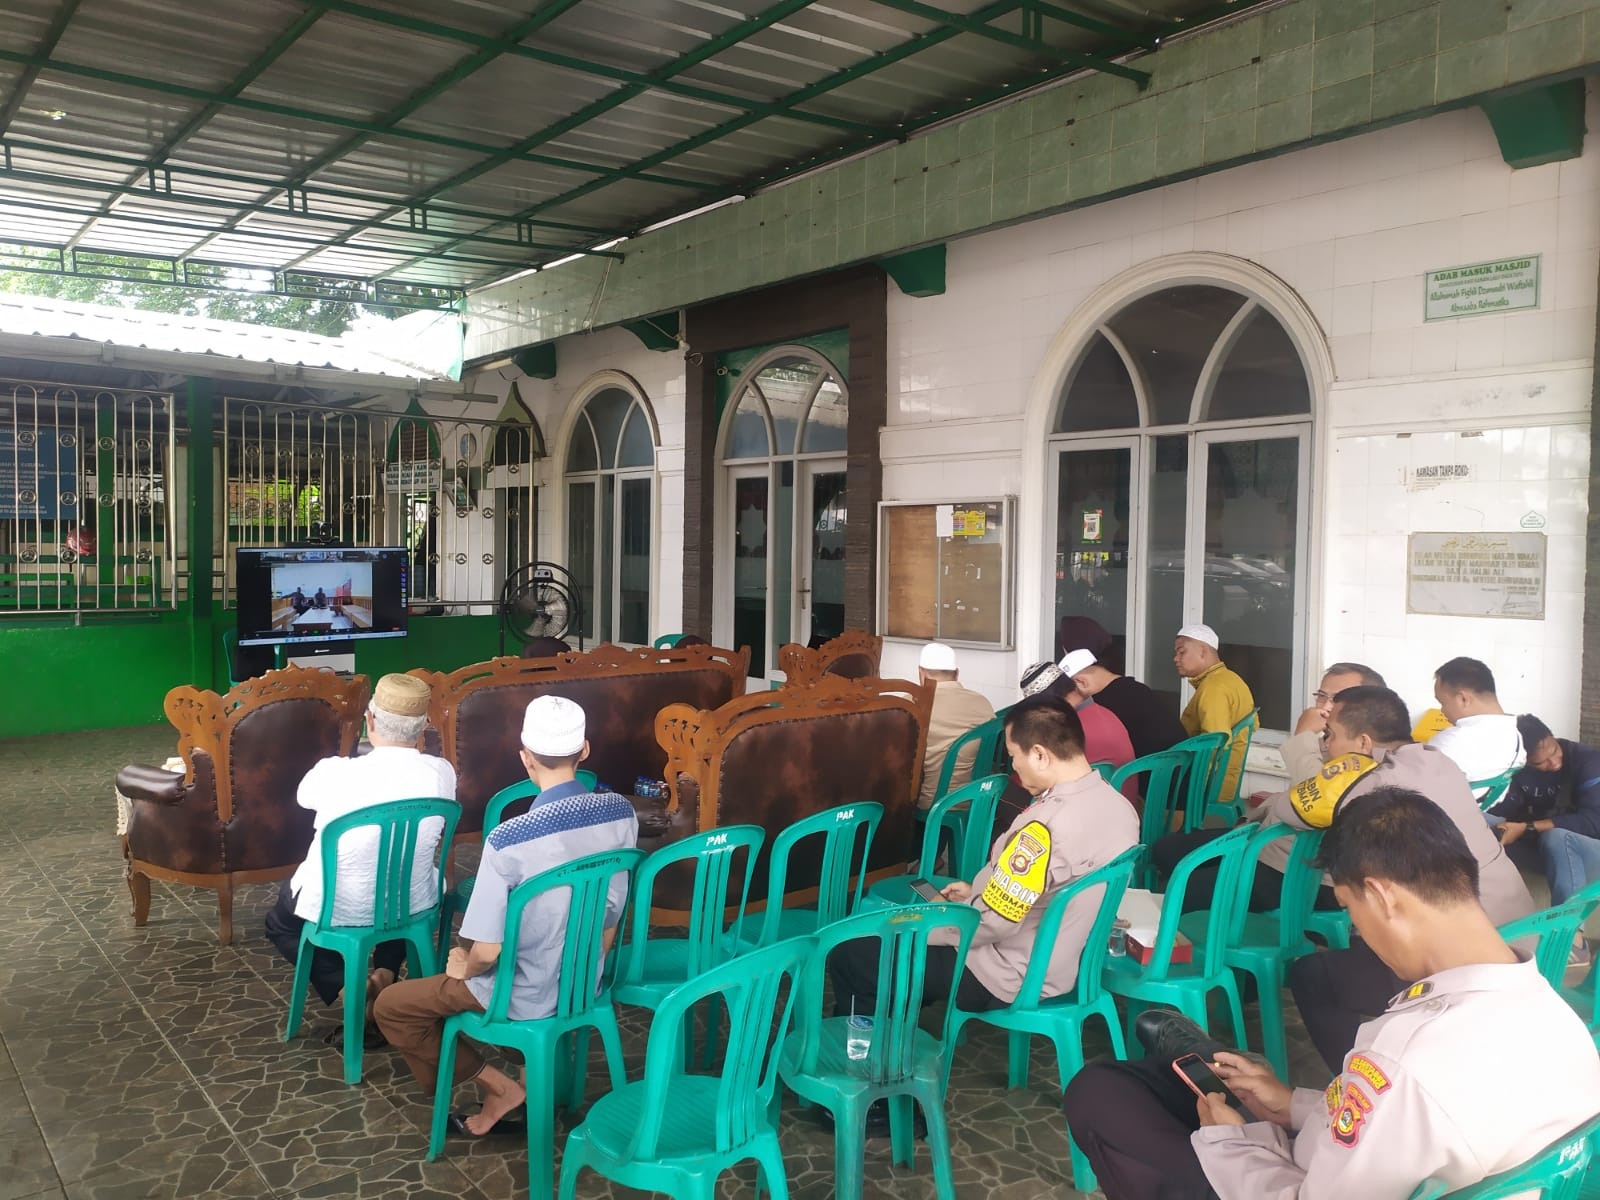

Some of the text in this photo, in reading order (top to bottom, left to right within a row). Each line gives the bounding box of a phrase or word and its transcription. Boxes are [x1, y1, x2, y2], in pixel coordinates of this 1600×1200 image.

[1433, 271, 1459, 282] ADAB
[1460, 265, 1493, 277] MASUK
[1494, 260, 1531, 273] MASJID
[835, 809, 855, 822] PAK
[705, 833, 728, 847] PAK
